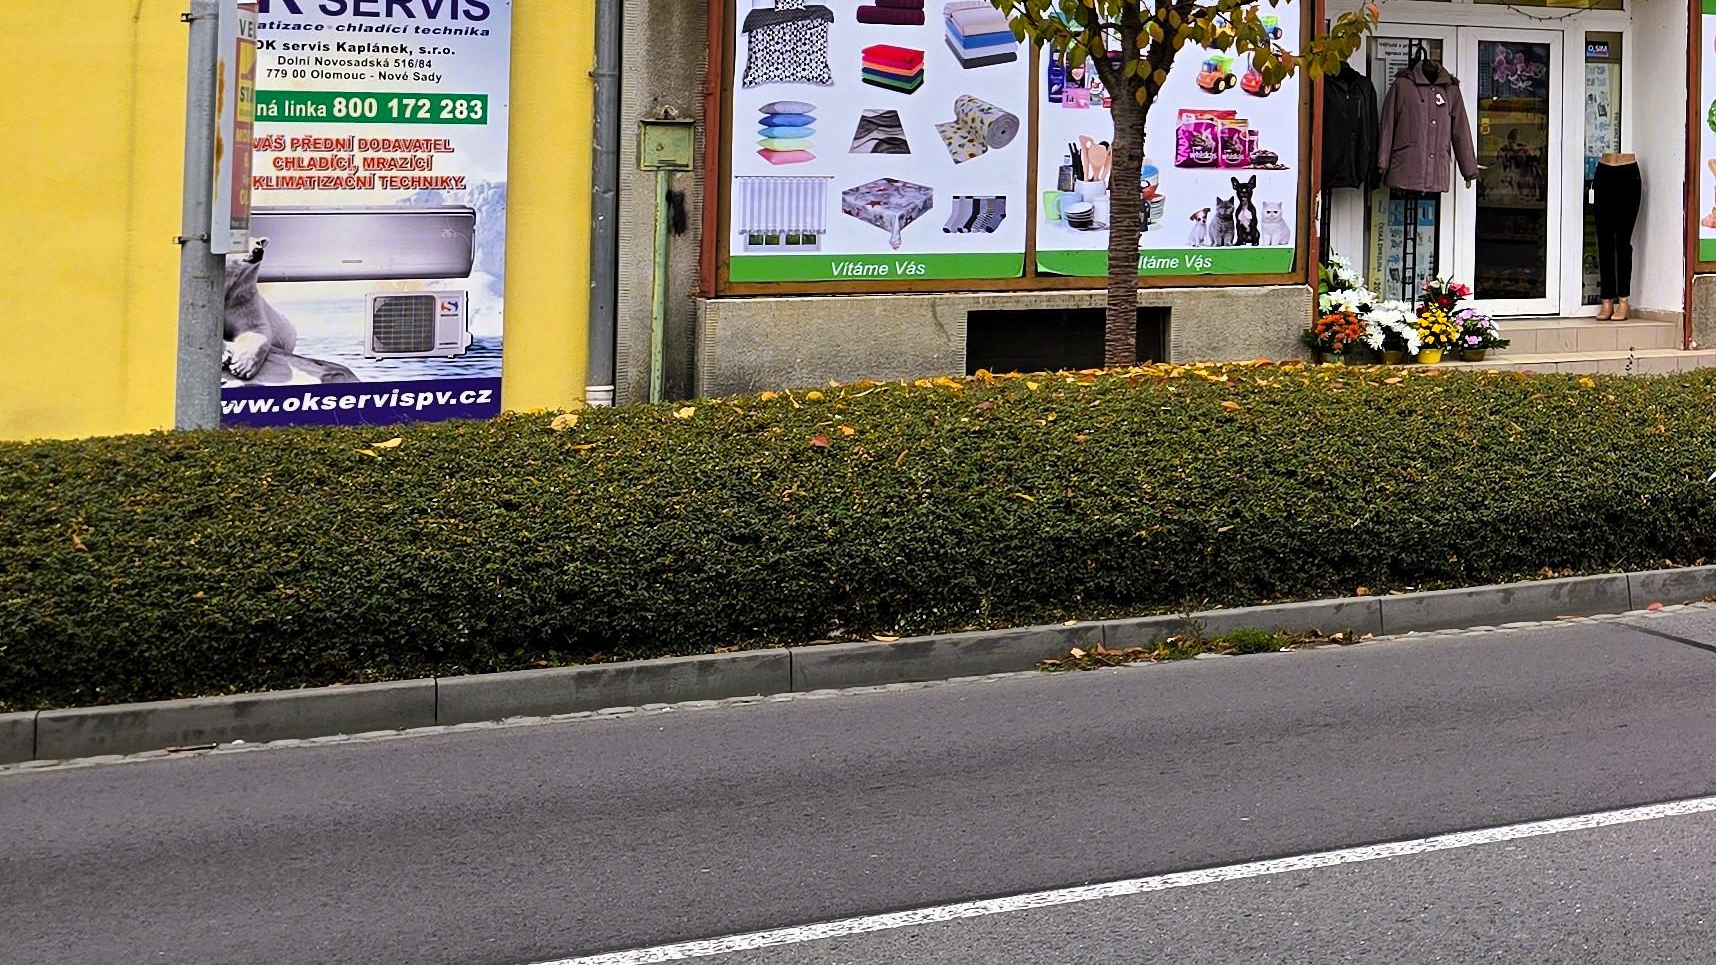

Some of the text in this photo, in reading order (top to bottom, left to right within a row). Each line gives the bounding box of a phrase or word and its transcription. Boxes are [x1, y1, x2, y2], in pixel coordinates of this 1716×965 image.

[335, 21, 409, 34] chladící
[414, 24, 490, 37] technika
[283, 41, 330, 52] servis
[336, 41, 413, 56] Kaplánek,
[418, 45, 456, 55] s.r.o.
[277, 56, 432, 69] Dolní Novosadská 516/84
[266, 69, 288, 79] 779
[292, 70, 306, 79] 00
[311, 70, 366, 80] Olomouc
[378, 71, 408, 81] Nové
[413, 72, 442, 83] Sady
[284, 99, 327, 117] linka
[333, 97, 378, 118] 800
[387, 98, 431, 119] 172
[439, 99, 483, 119] 283
[290, 135, 355, 152] PŘEDNÍ
[358, 138, 454, 153] DODAVATEL
[272, 154, 434, 174] CHLADÍCÍ, MRAZÍCÍ
[252, 173, 466, 190] KLIMATIZAČNÍ TECHNIKY
[830, 260, 926, 277] Vítáme Vás
[1137, 254, 1212, 269] ítáme Vás
